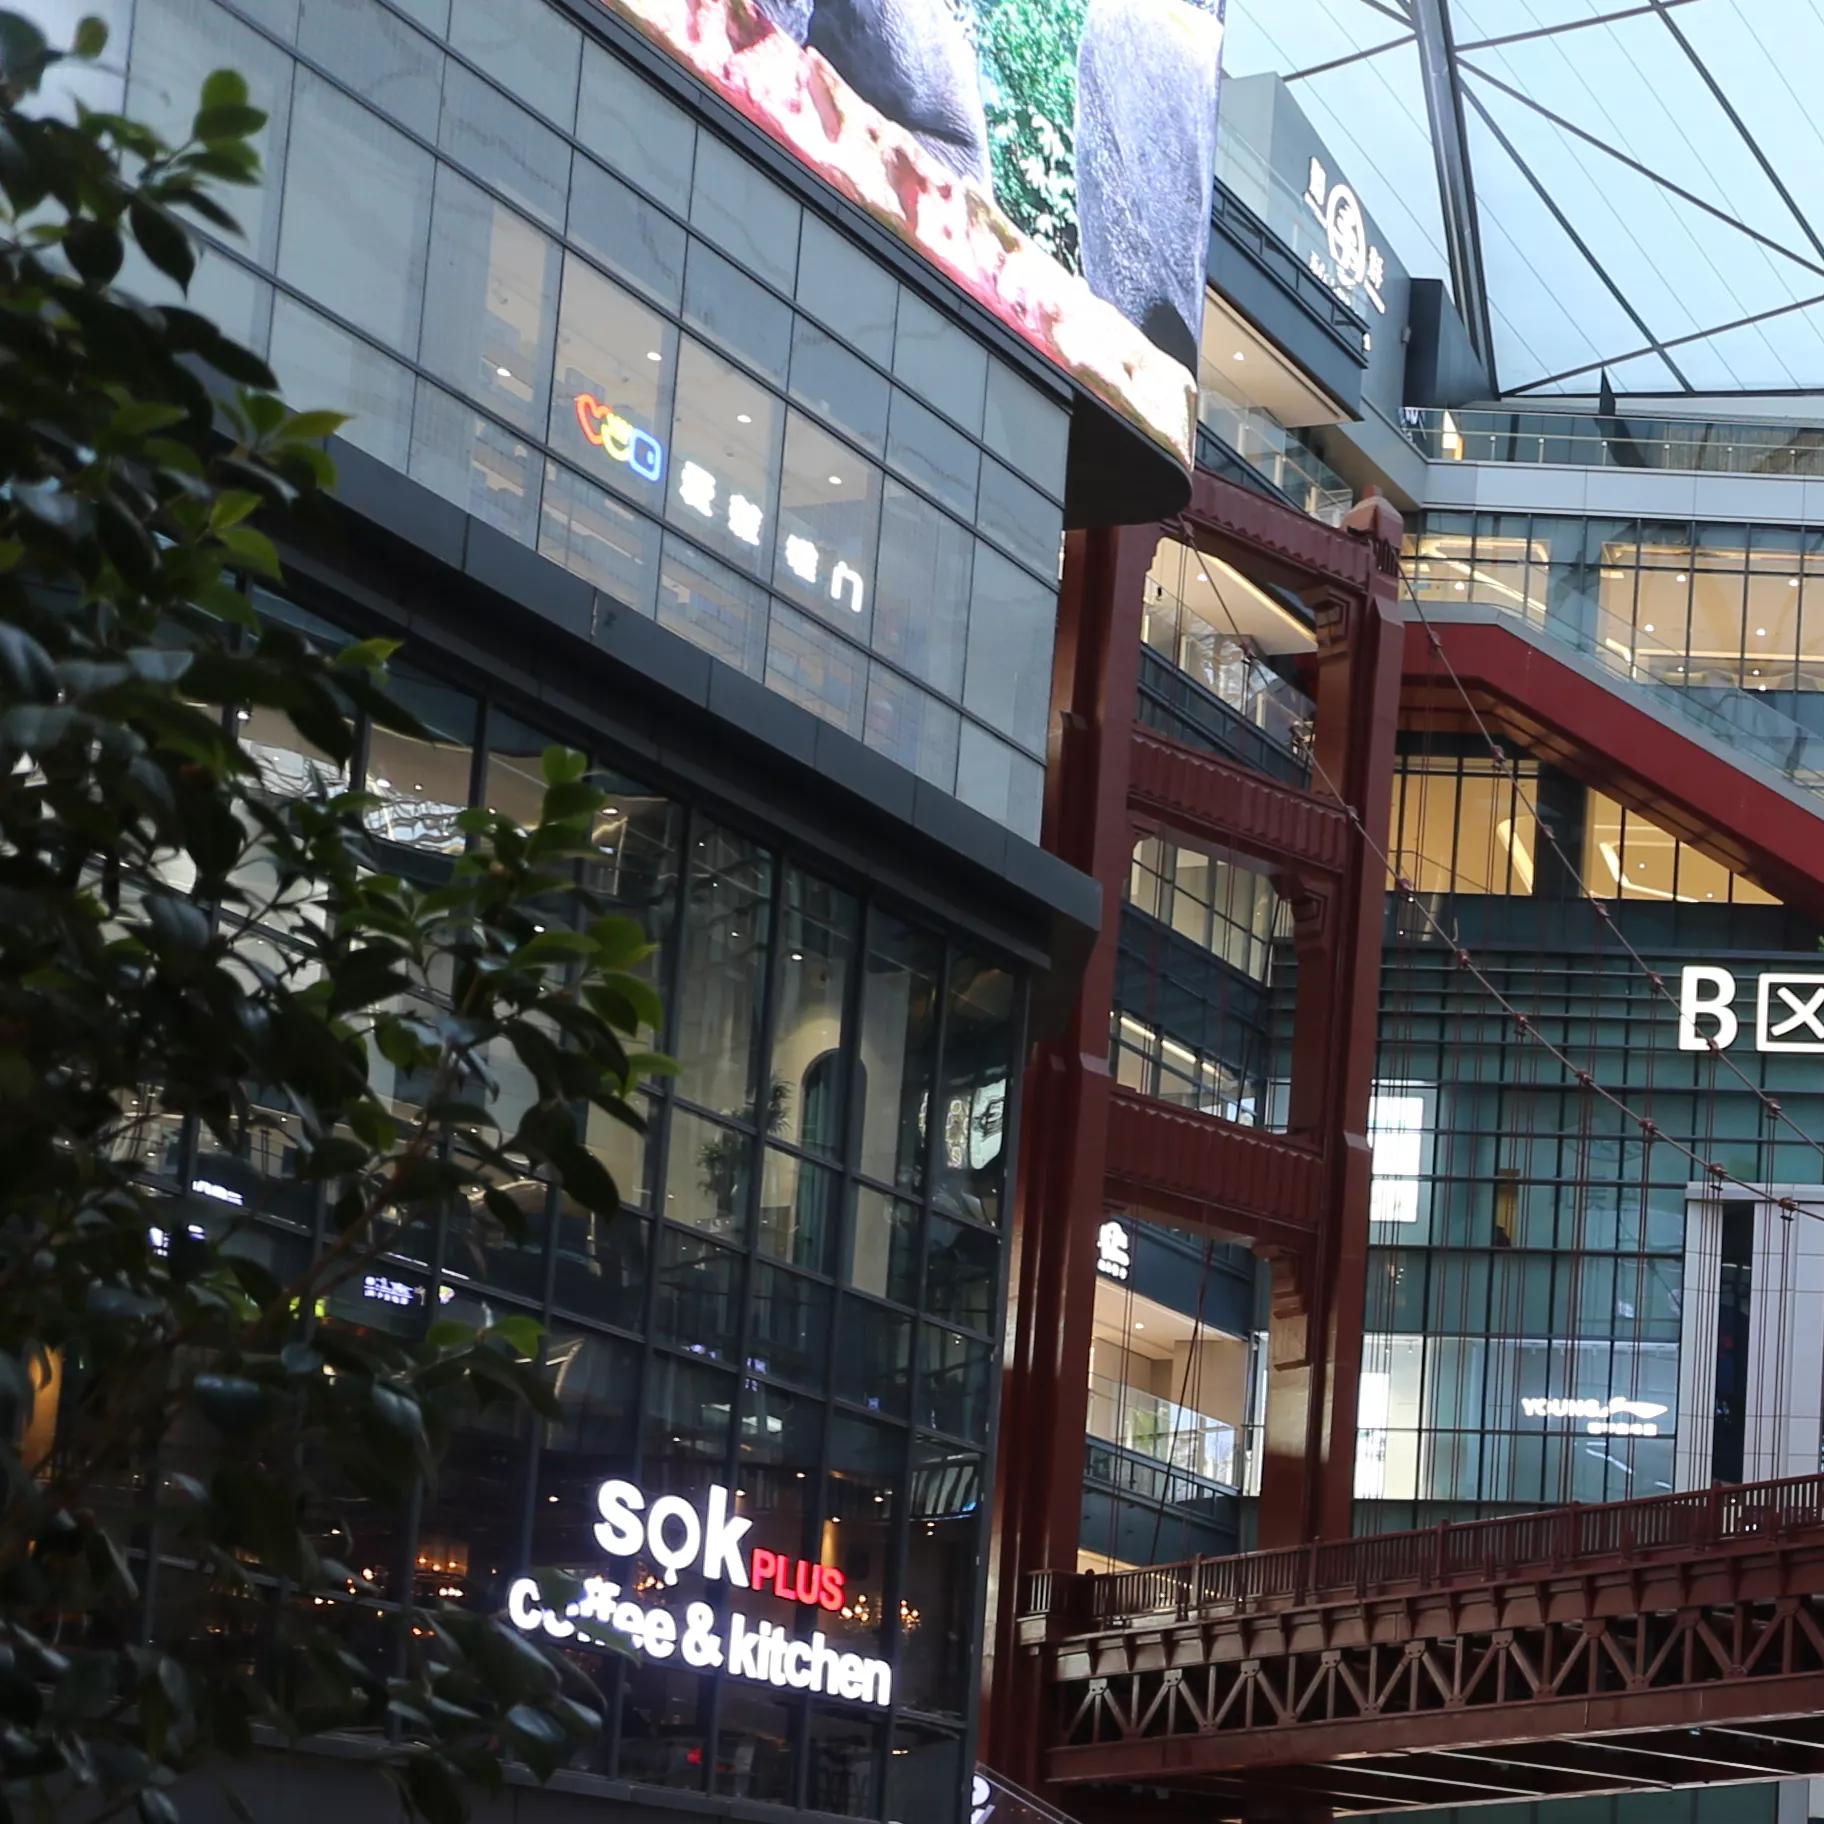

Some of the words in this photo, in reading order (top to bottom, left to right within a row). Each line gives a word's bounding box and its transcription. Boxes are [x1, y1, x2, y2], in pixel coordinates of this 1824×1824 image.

[752, 1548, 845, 1612] PLUS
[681, 1602, 723, 1667] &
[728, 1613, 891, 1706] kitchen
